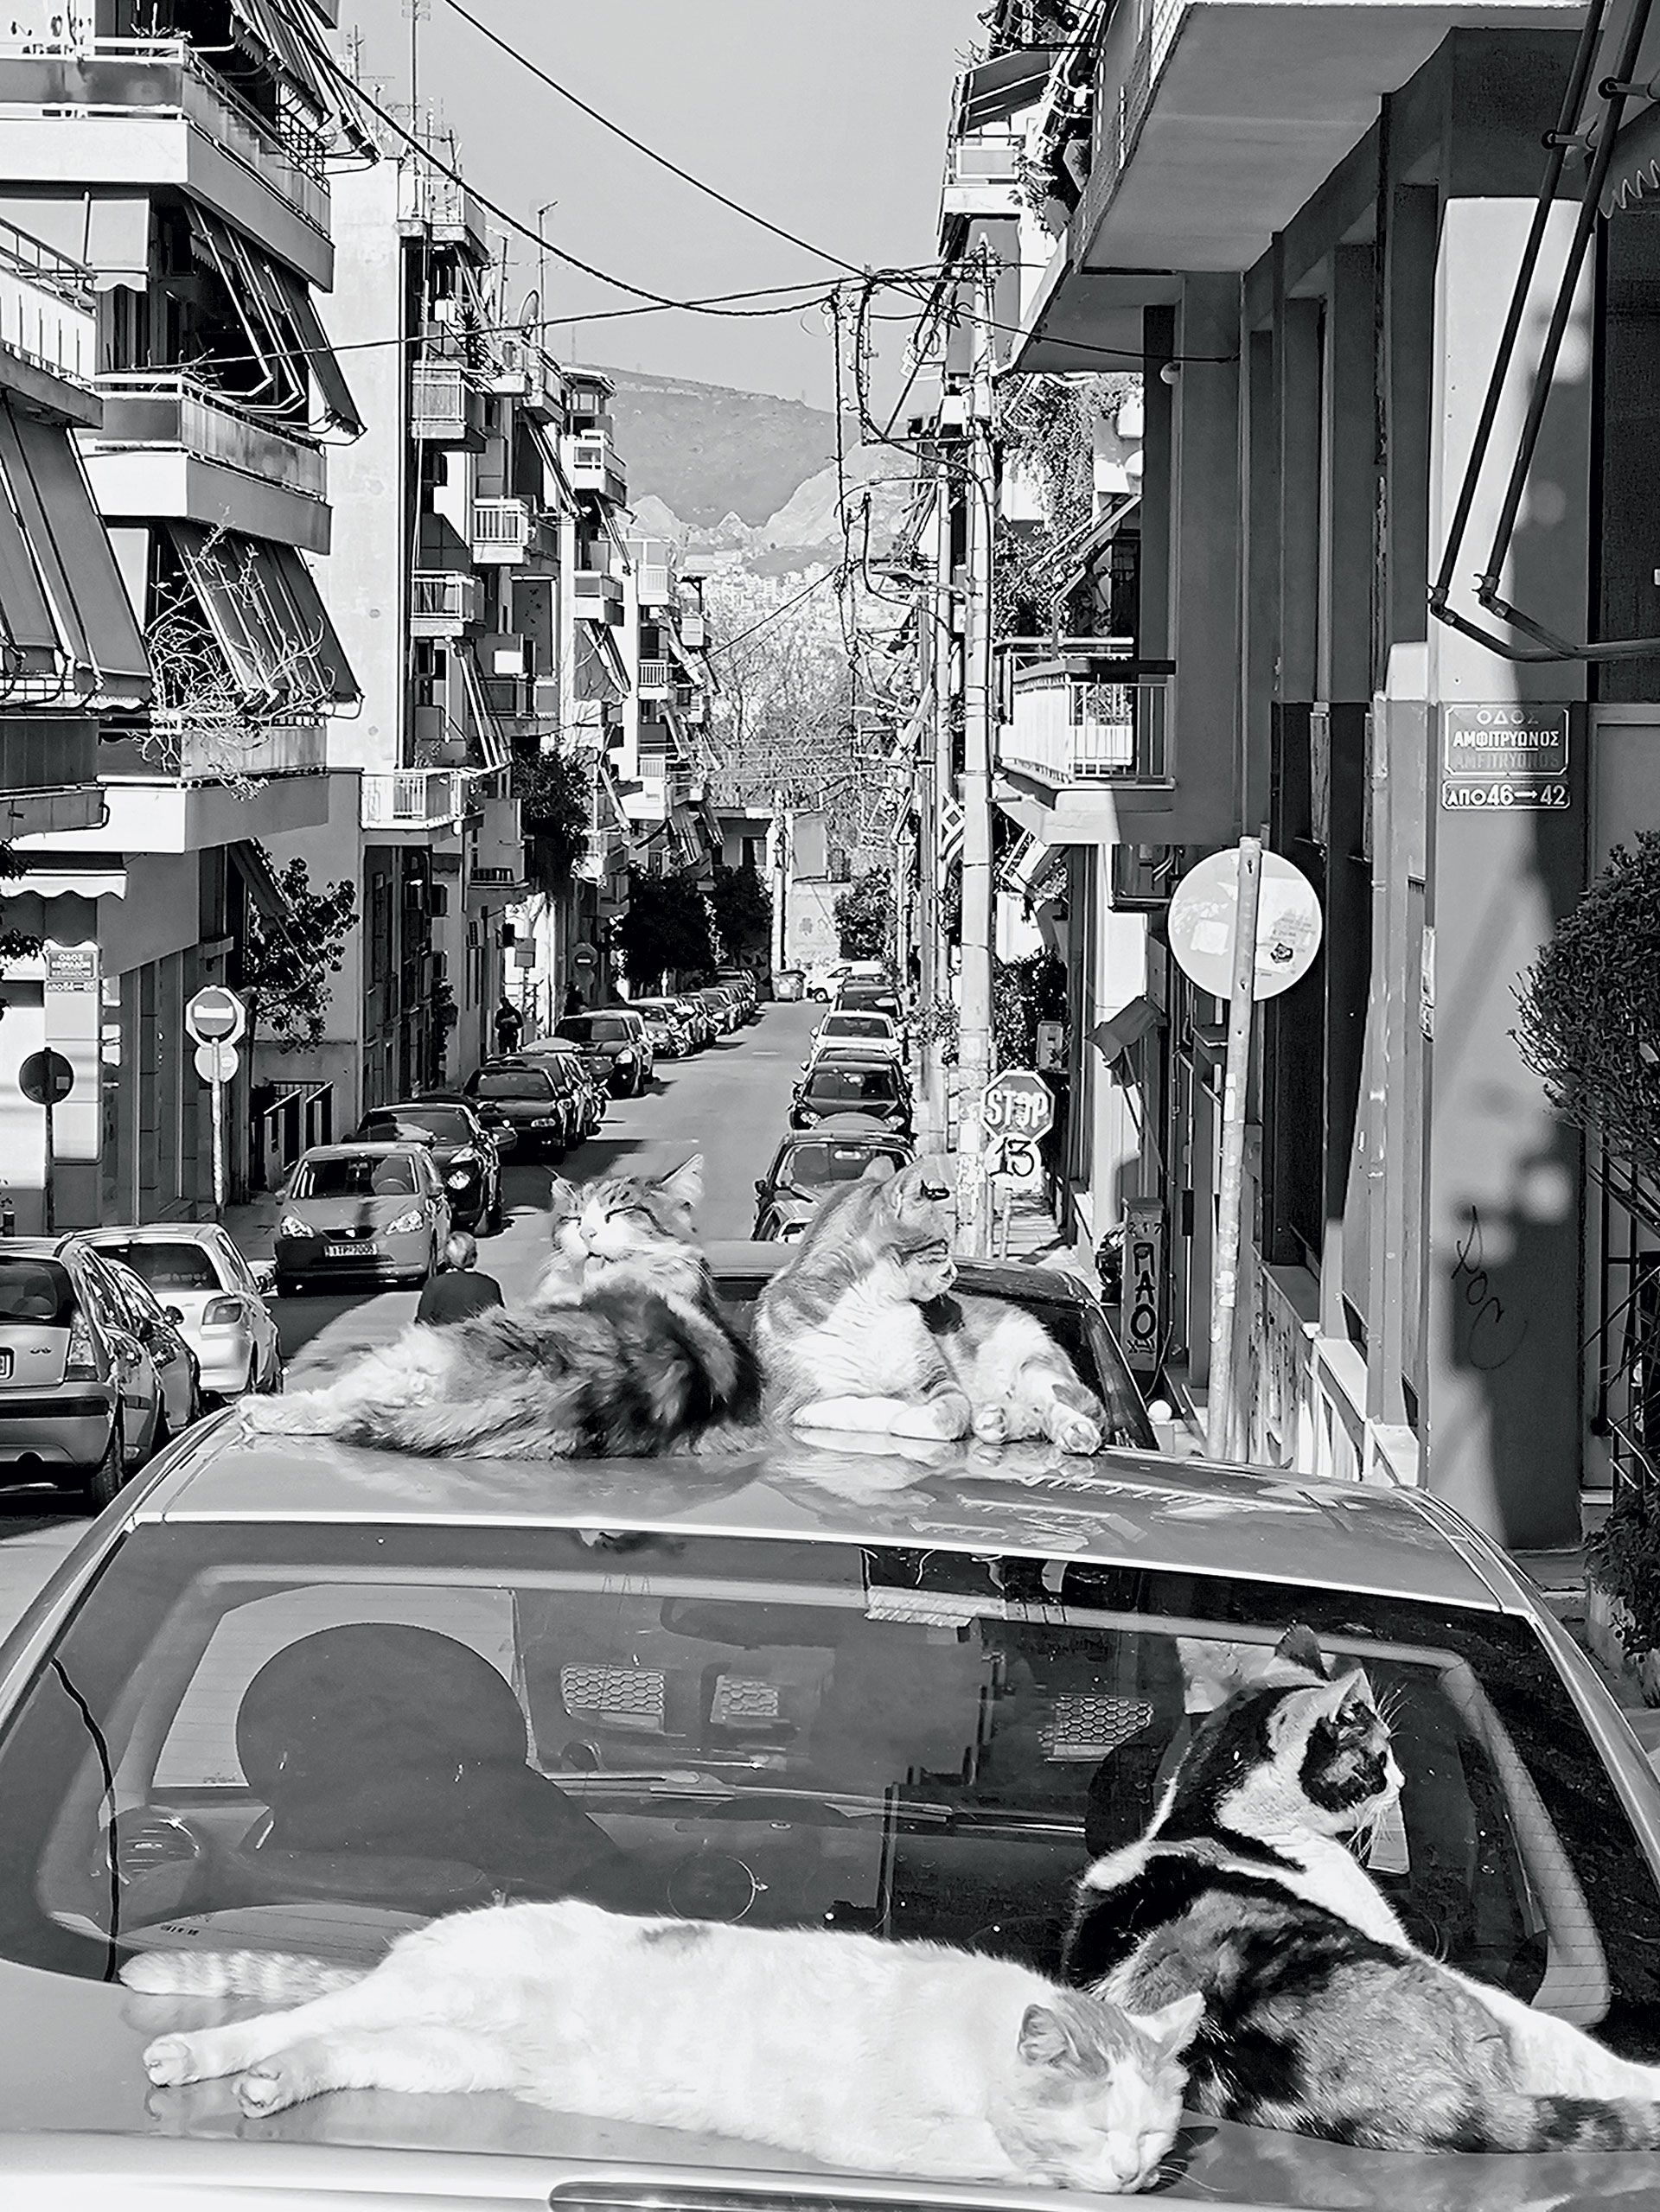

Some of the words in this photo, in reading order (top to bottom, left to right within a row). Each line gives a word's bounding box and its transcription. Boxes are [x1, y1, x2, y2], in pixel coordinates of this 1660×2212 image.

[1477, 709, 1539, 725] ΟΔΟΣ
[1452, 730, 1560, 749] ΑΜΦΙΤΡΥΩΝΟΣ
[1540, 784, 1566, 806] 42
[986, 1089, 1049, 1129] STOP
[988, 1137, 1035, 1177] 13
